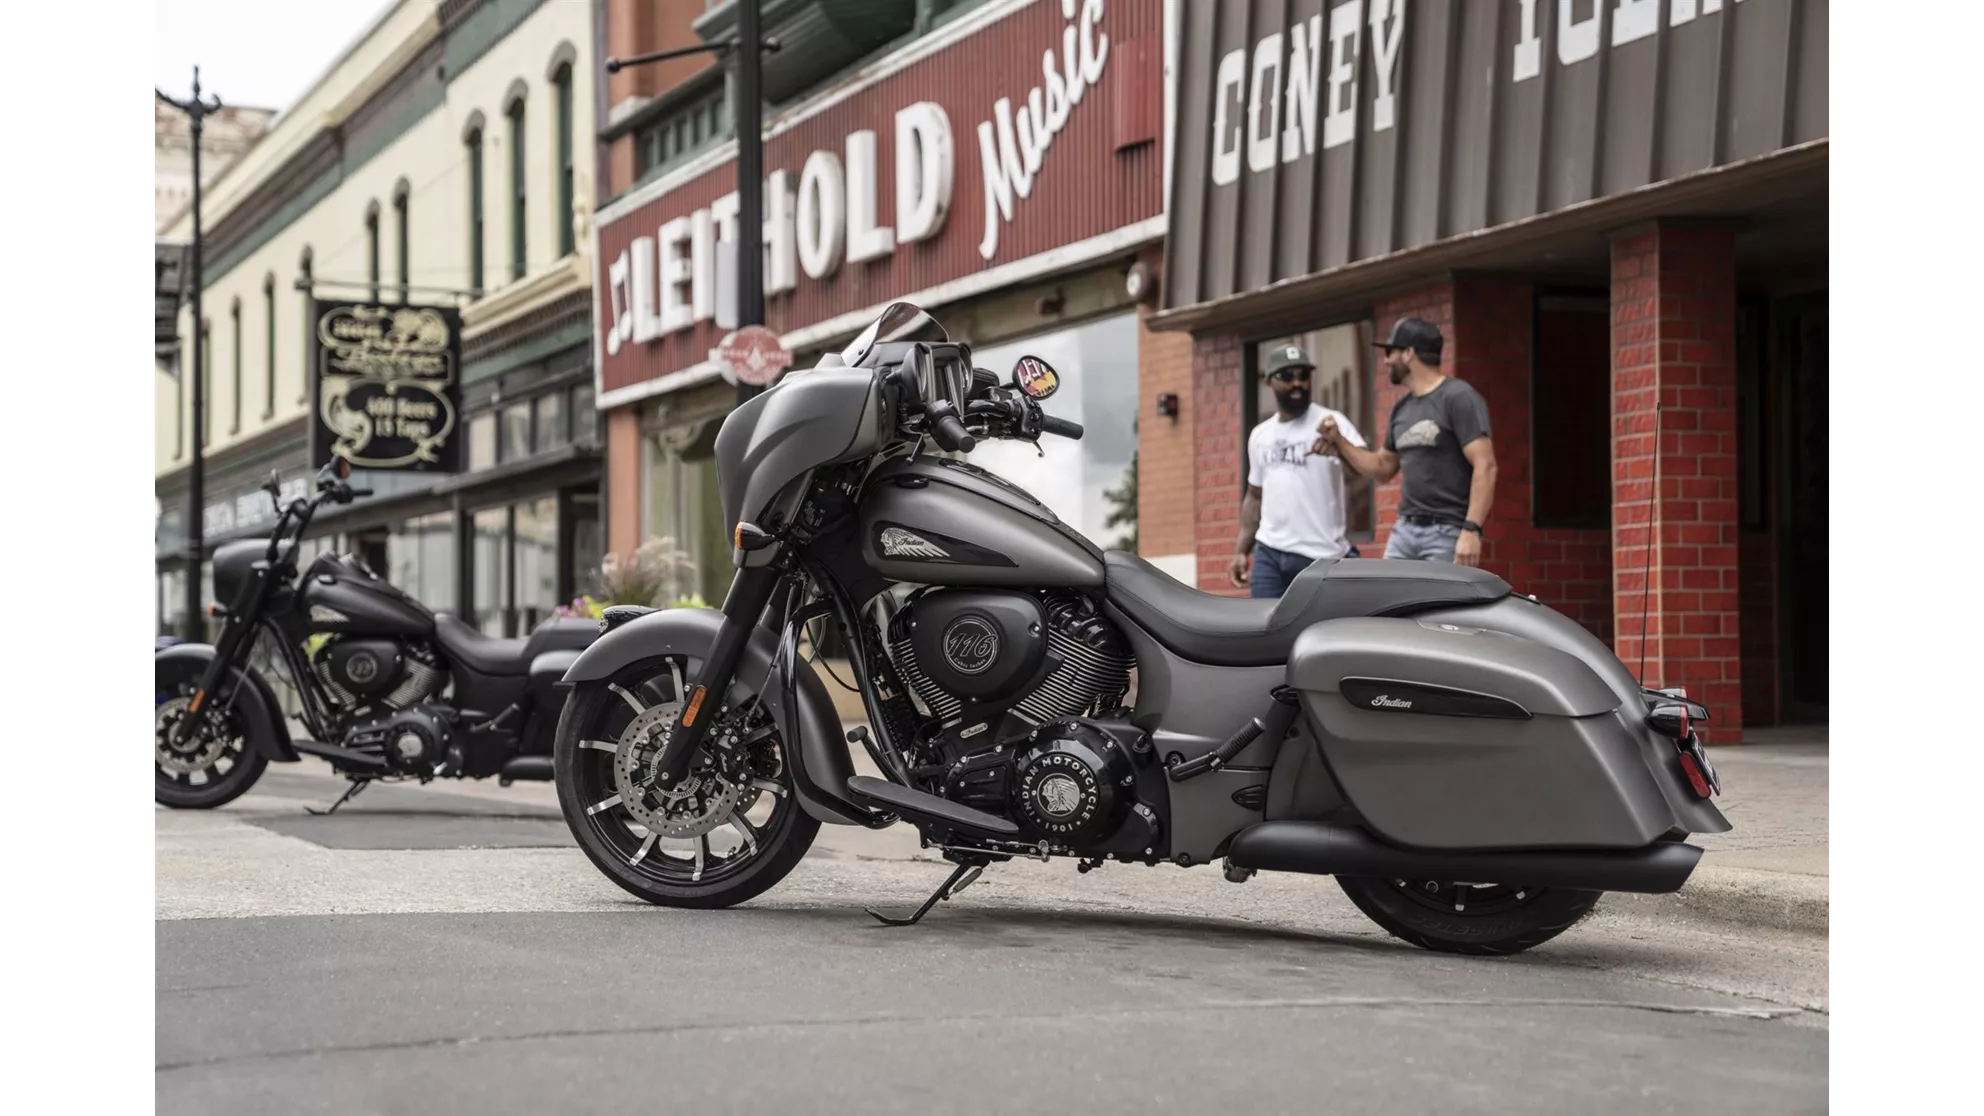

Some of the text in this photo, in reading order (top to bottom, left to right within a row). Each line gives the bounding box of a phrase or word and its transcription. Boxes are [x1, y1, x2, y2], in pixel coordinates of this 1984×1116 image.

[1212, 0, 1405, 186] CONEY
[977, 0, 1108, 260] Music
[897, 537, 925, 547] Indian
[948, 632, 998, 657] 116
[1371, 694, 1412, 709] Indian
[1021, 756, 1097, 820] INDIAN MOTORCYCLE
[1045, 822, 1073, 832] 1901
